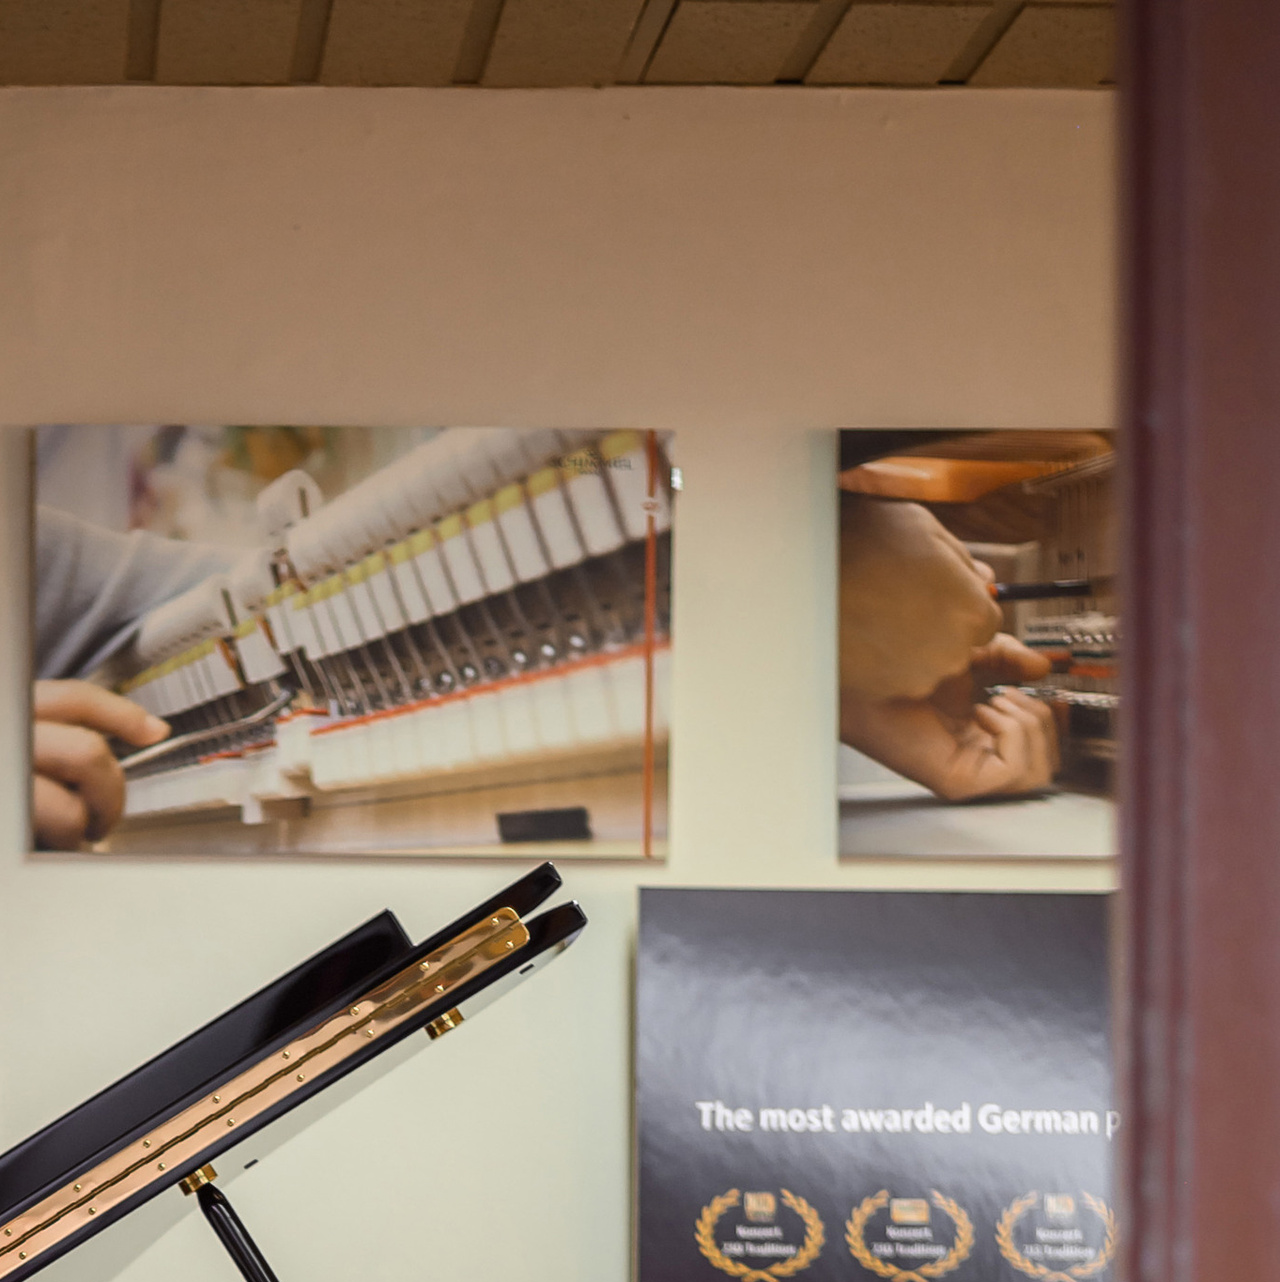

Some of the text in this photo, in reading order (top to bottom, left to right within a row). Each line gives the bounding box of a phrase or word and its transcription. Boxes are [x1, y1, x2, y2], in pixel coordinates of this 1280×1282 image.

[696, 1101, 753, 1132] The
[760, 1104, 834, 1132] most
[841, 1102, 970, 1134] awarded
[976, 1102, 1098, 1135] German
